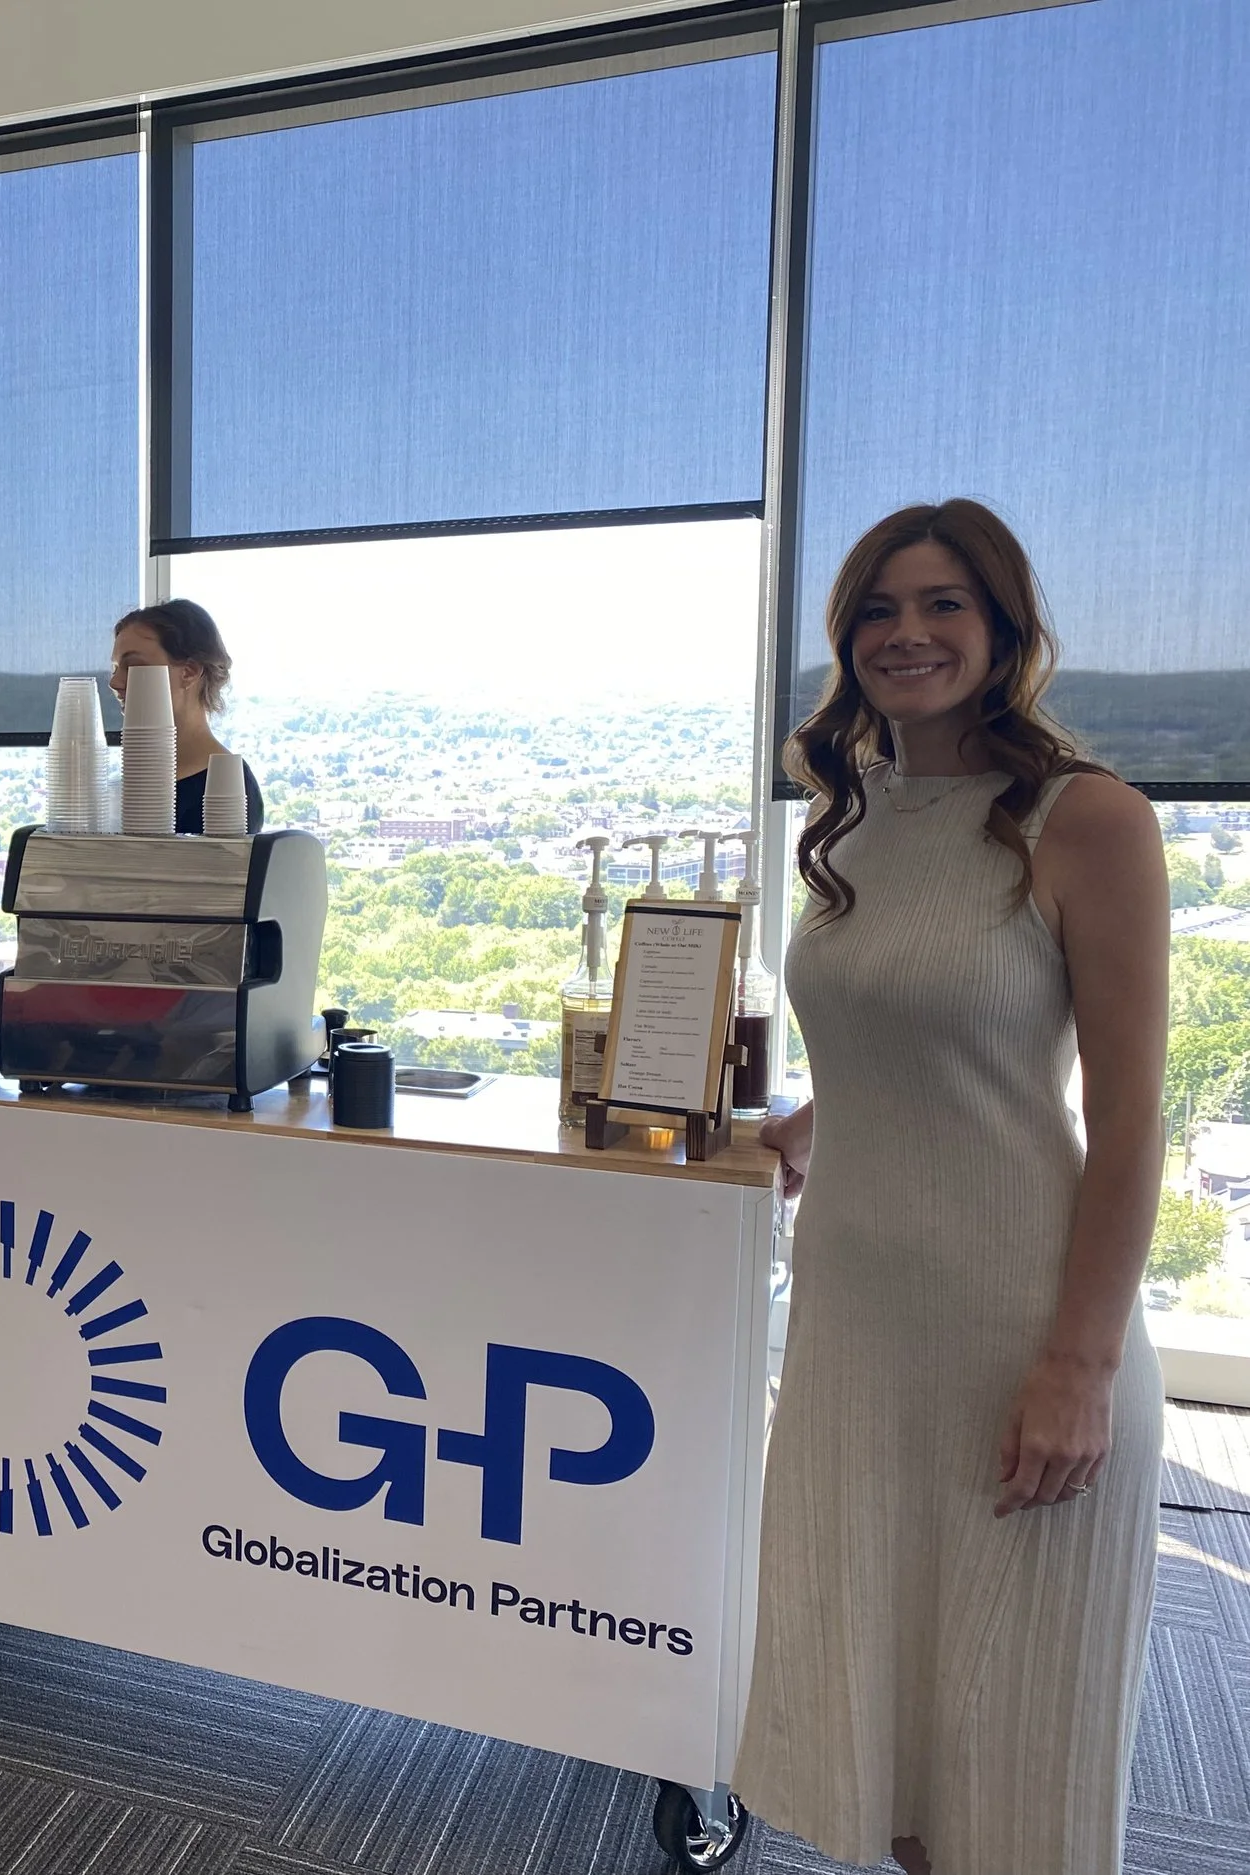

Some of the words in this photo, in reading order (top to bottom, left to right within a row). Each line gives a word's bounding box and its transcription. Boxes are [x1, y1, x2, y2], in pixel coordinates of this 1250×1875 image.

[646, 927, 670, 936] NEW
[683, 928, 703, 937] LIFE
[201, 1524, 475, 1611] Globalization
[490, 1581, 694, 1656] Partners
